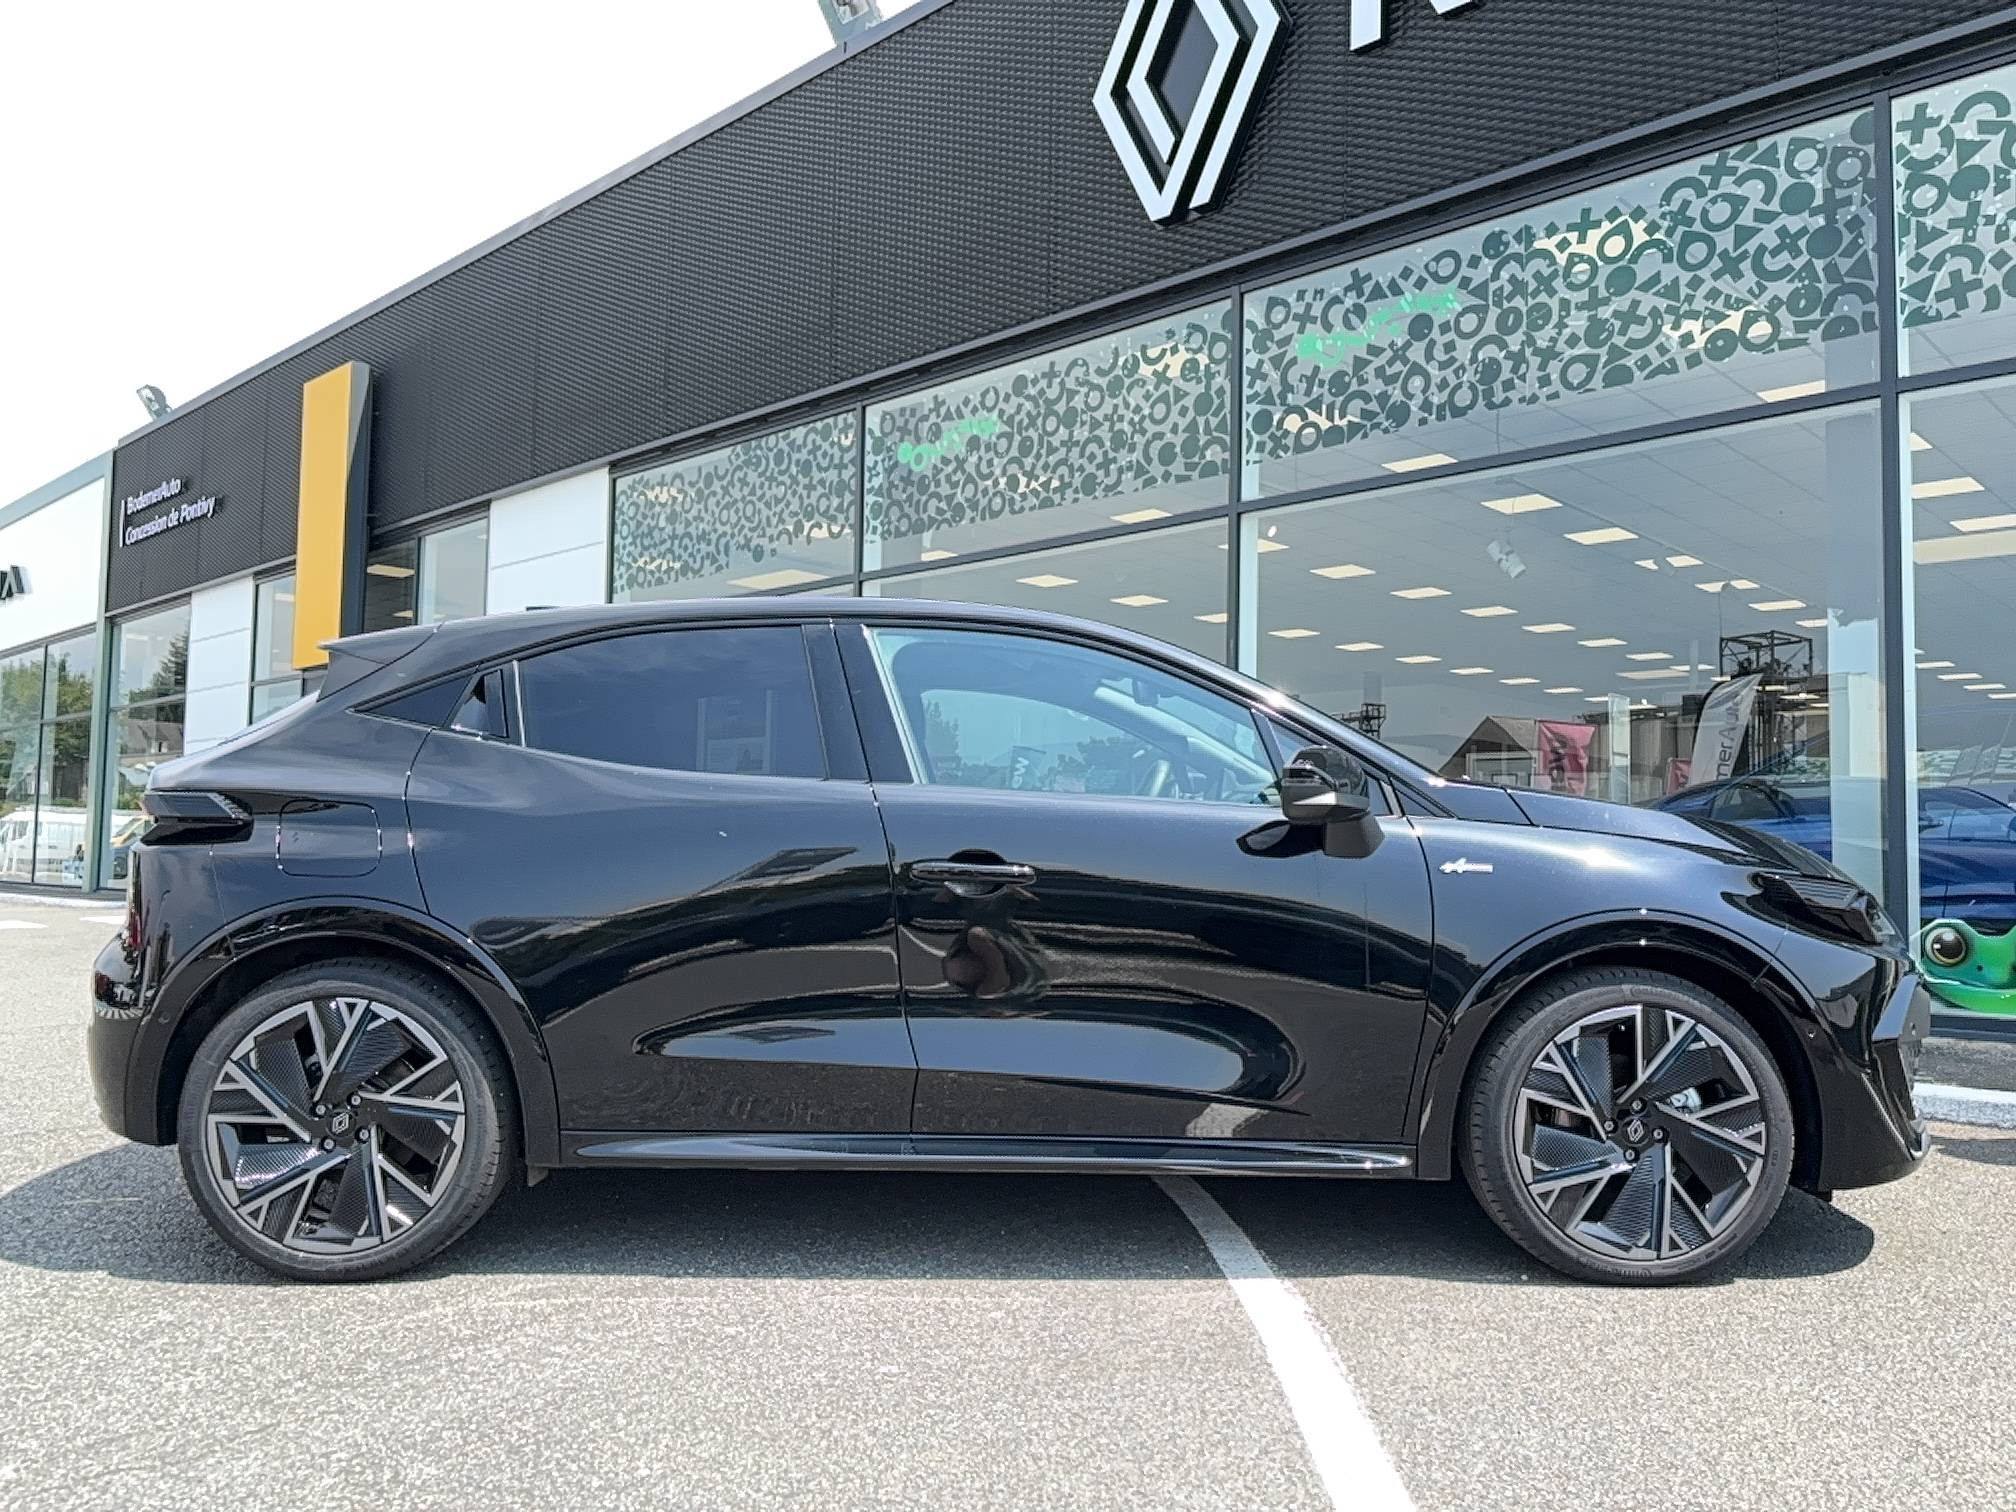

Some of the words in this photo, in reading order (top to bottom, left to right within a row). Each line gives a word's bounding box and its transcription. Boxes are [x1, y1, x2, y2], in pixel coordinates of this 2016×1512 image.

[125, 515, 167, 545] Concession
[168, 508, 179, 528] de
[179, 496, 216, 524] Pontivy
